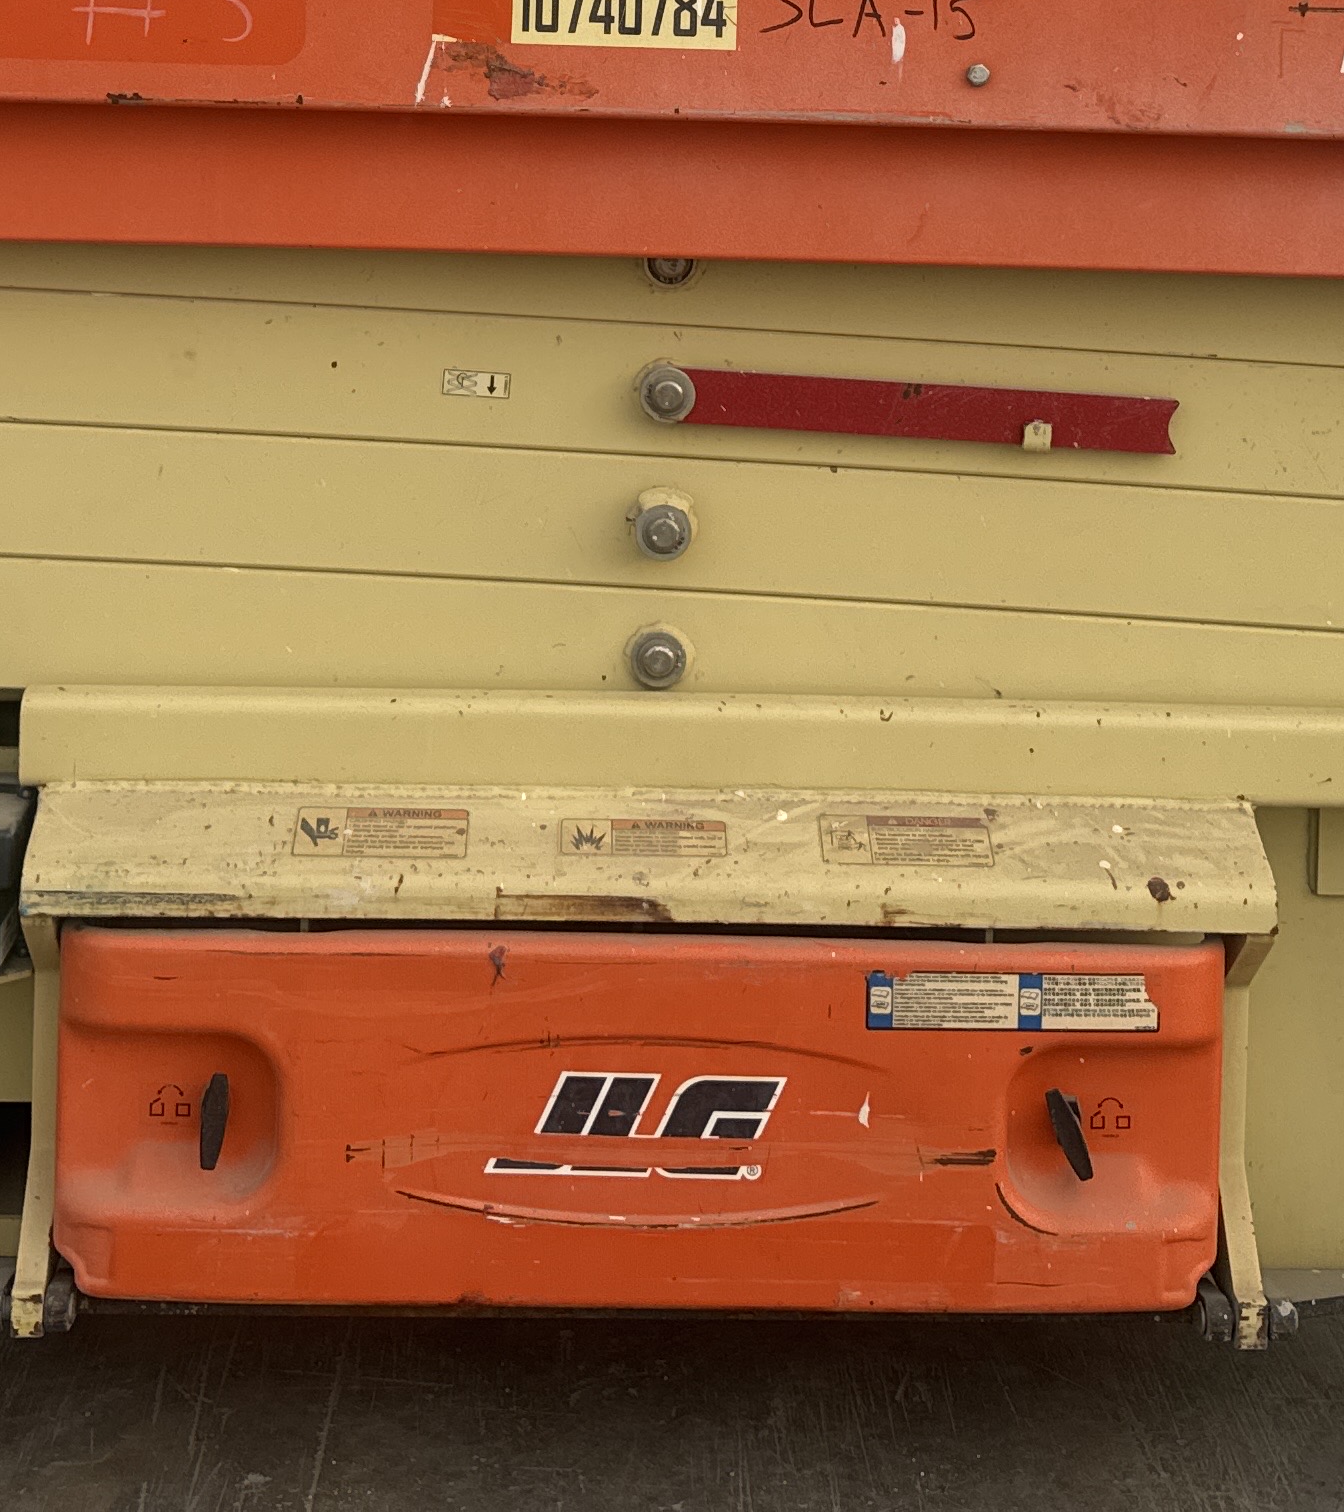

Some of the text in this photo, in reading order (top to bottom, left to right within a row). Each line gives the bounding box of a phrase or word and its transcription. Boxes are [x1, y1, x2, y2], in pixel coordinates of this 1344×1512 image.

[382, 809, 442, 819] WARNING
[644, 821, 705, 830] WARNING
[906, 817, 952, 826] DANGER
